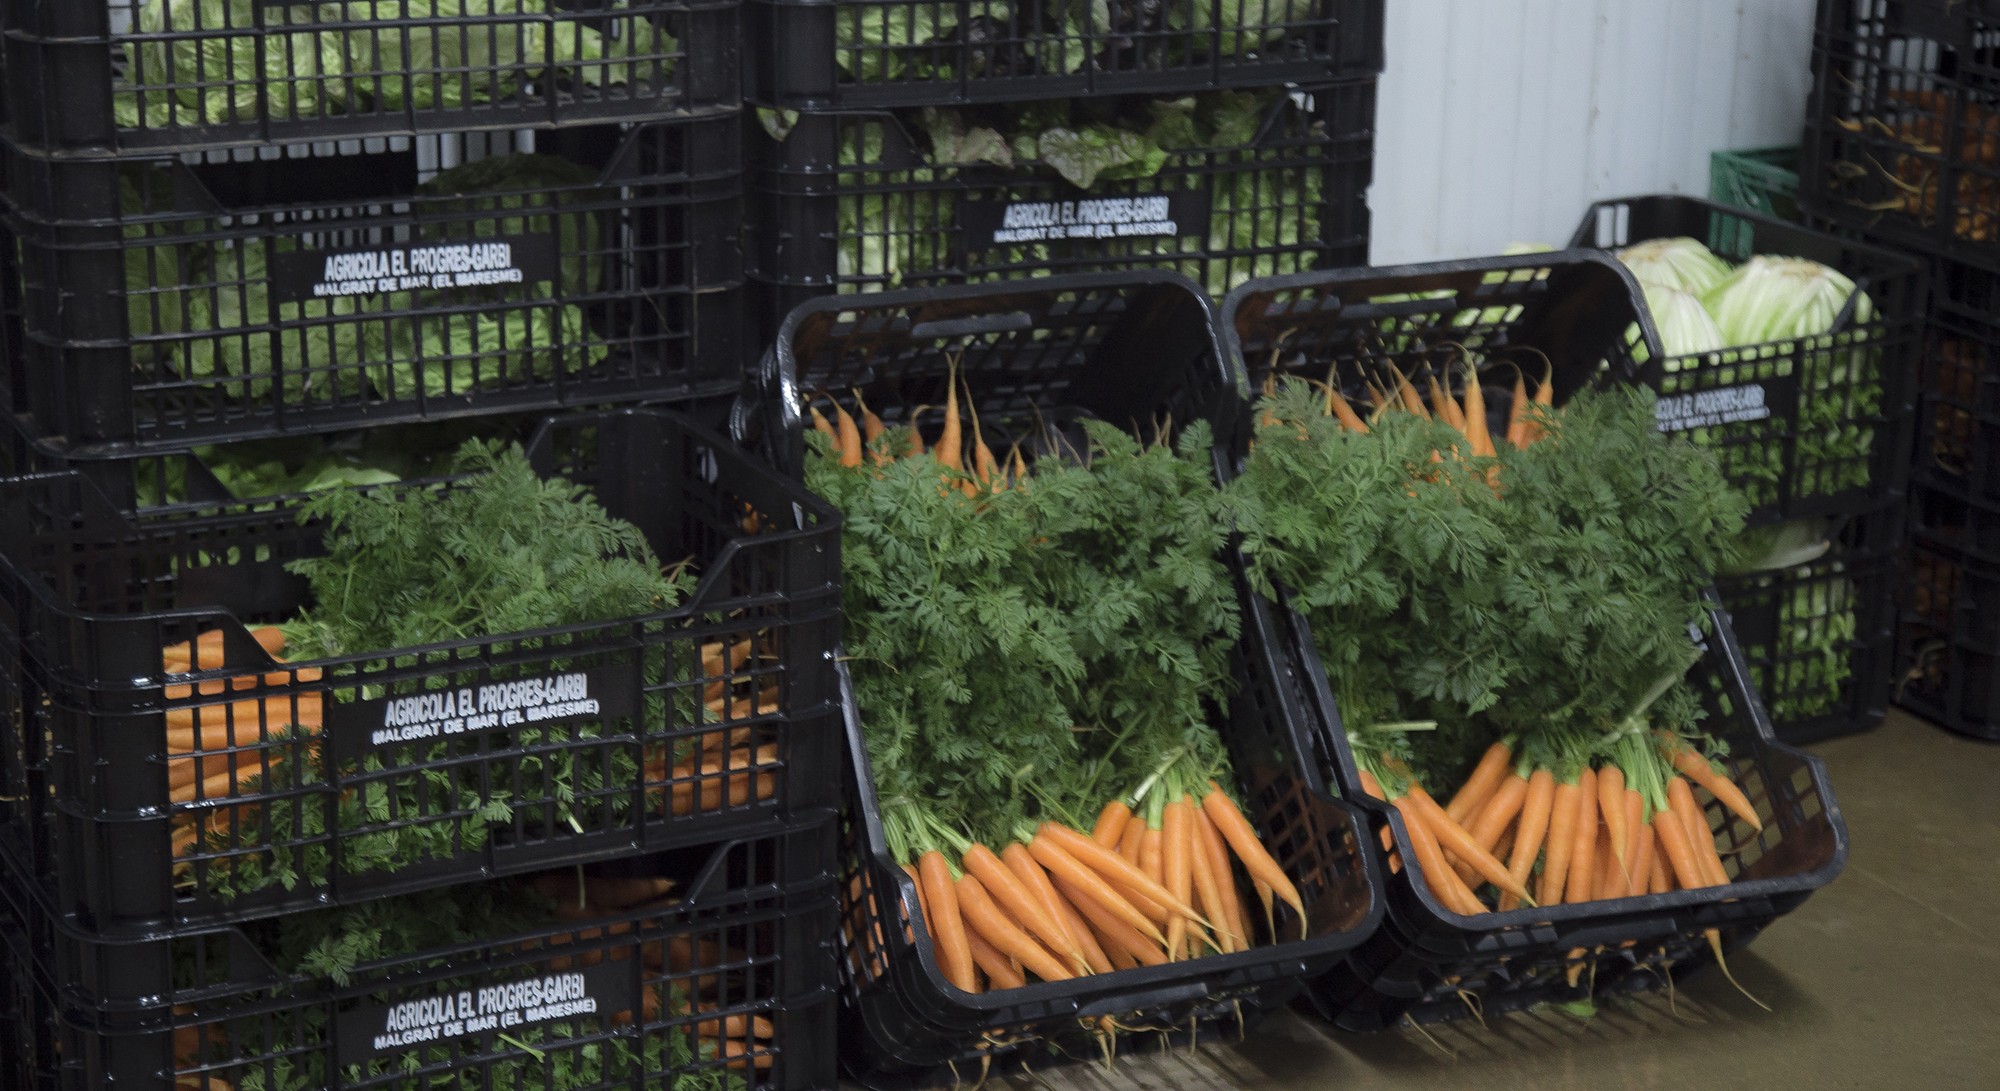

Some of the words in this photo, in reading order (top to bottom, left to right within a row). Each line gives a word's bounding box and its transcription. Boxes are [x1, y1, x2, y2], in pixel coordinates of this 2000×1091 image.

[313, 279, 376, 297] MALGRAT
[378, 278, 398, 292] DE
[401, 275, 429, 290] MAR
[432, 274, 453, 289] (EL
[324, 251, 389, 282] AGRICOLA
[391, 250, 408, 276] EL
[411, 243, 511, 273] PROGRES-GARBI
[372, 722, 441, 745] MALGRAT
[444, 718, 464, 734] DE
[467, 713, 498, 730] MAR
[501, 711, 525, 727] (EL
[526, 699, 600, 721] MARESME)
[385, 691, 456, 727] AGRICOLA
[458, 689, 476, 716] EL
[479, 673, 587, 713] PROGRES-GARBI
[374, 1026, 441, 1050] MALGRAT
[443, 1021, 464, 1037] DE
[466, 1015, 498, 1033] MAR
[501, 1012, 523, 1029] (EL
[526, 998, 597, 1022] MARESME)
[386, 995, 456, 1032] AGRICOLA
[458, 991, 476, 1019] EL
[478, 973, 585, 1015] PROGRES-GARBI
